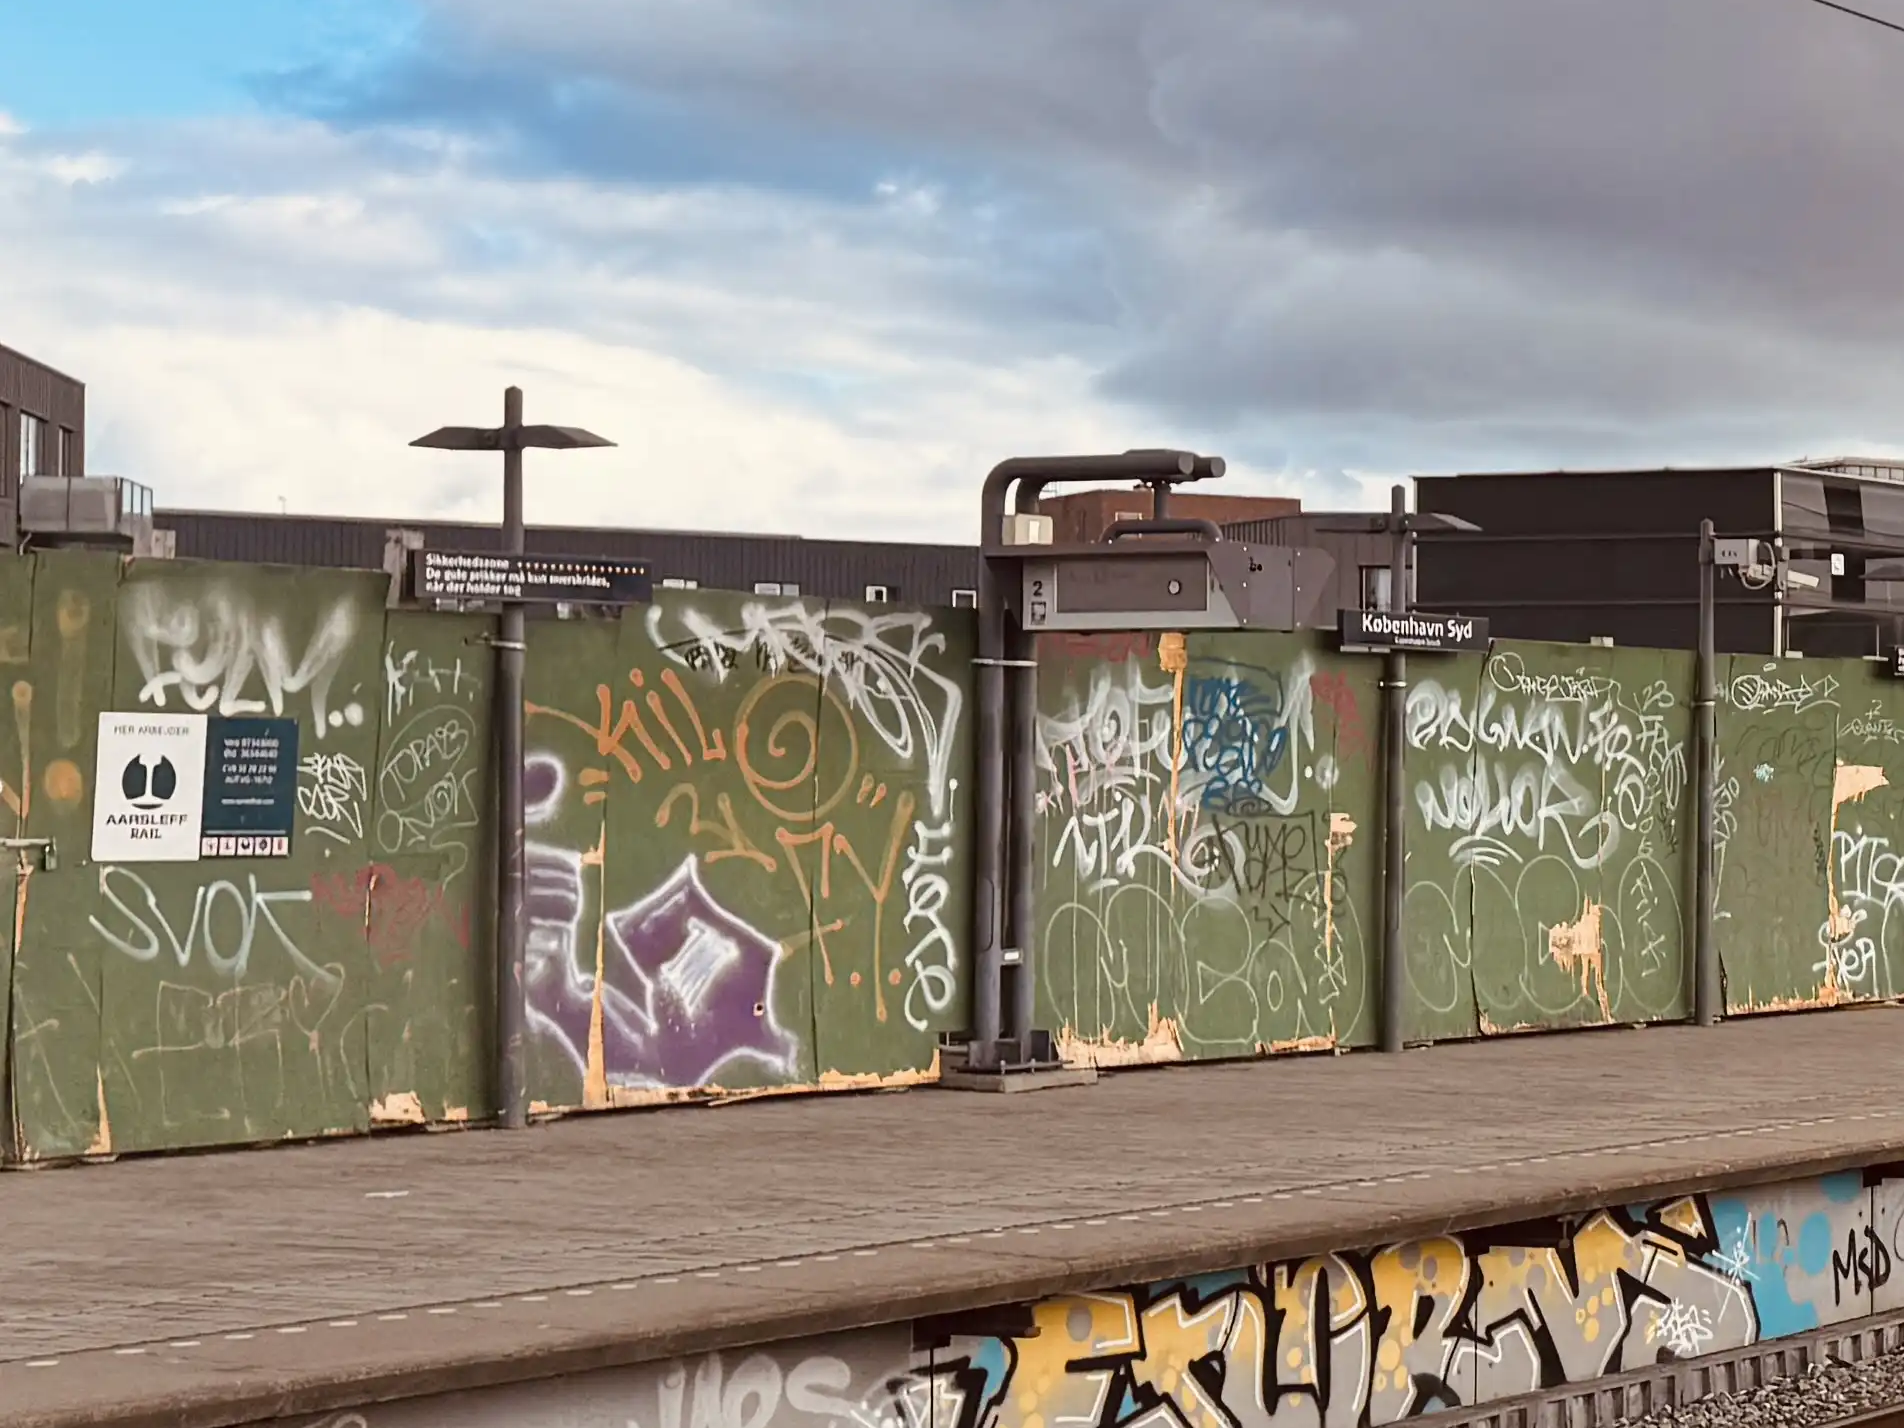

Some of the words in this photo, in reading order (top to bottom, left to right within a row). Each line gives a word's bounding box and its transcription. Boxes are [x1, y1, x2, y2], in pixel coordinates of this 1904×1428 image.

[1032, 580, 1044, 597] 2
[1362, 612, 1444, 637] København
[1447, 619, 1473, 643] Syd
[130, 827, 163, 840] RAIL
